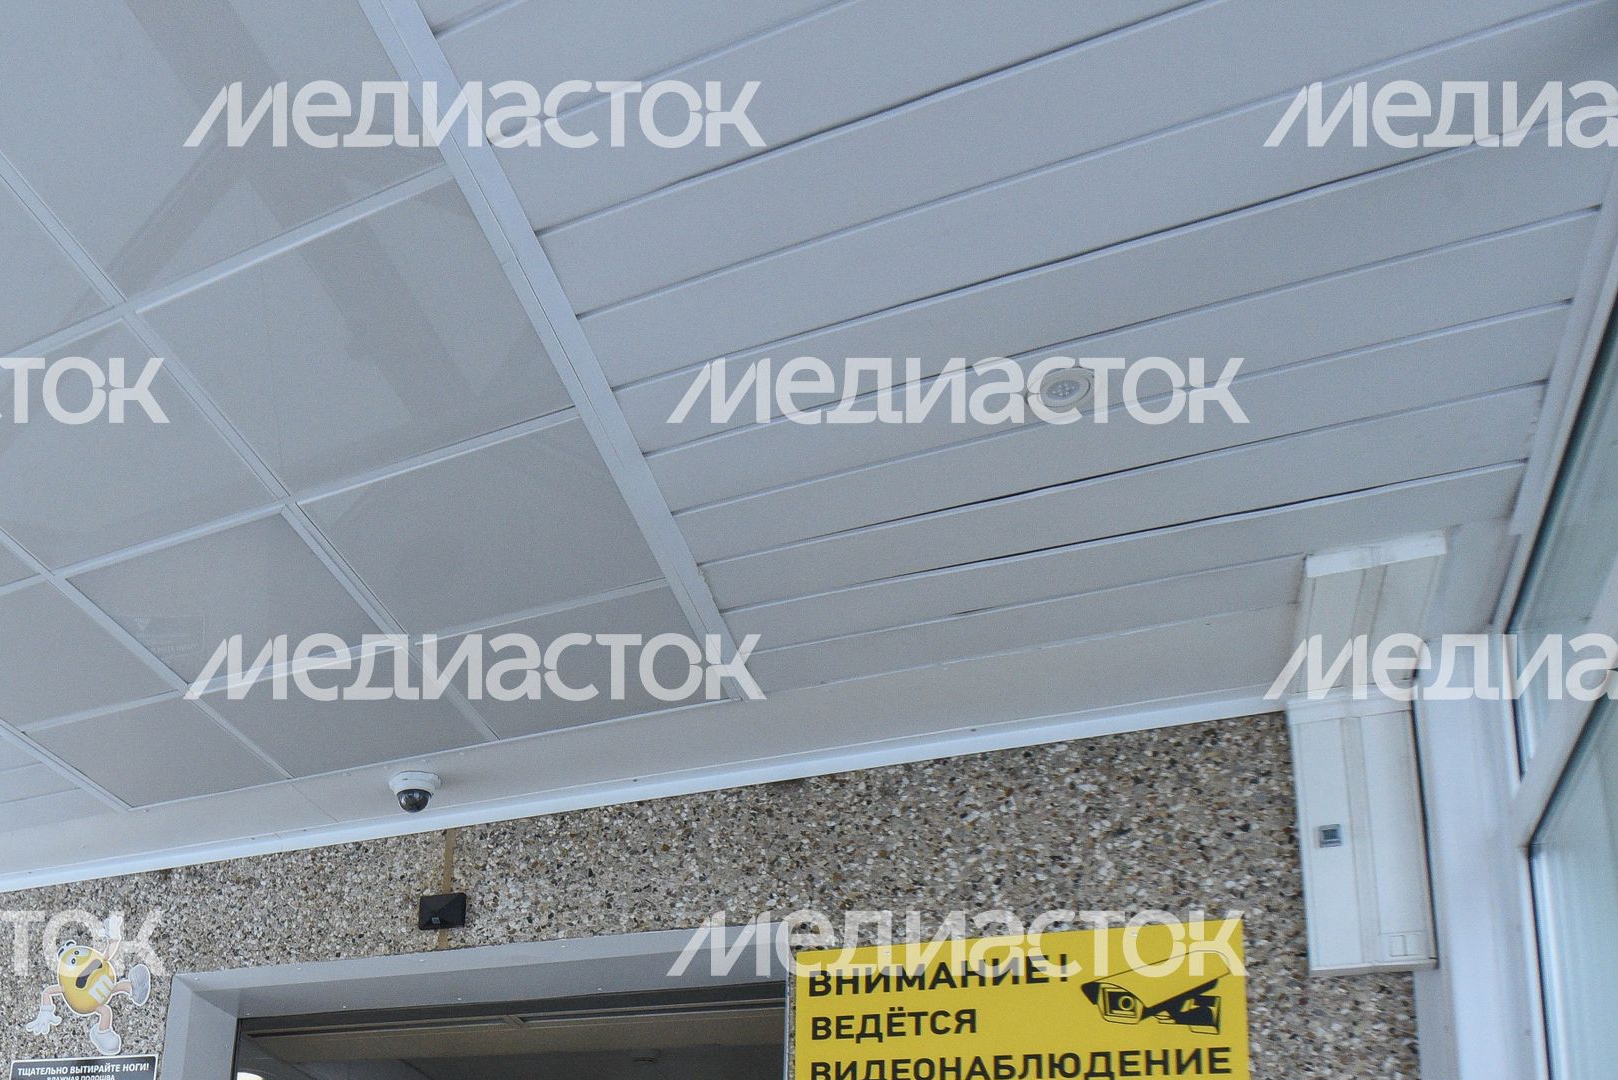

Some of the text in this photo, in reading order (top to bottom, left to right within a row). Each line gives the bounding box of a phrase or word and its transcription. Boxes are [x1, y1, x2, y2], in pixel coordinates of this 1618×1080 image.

[808, 953, 1069, 998] ВНИМАНИЕ!
[811, 1008, 977, 1044] ВЕДЁТСЯ
[17, 1062, 150, 1077] ТЩАТЕЛЬНО ВЫТИРАЙТЕ НОГИ!
